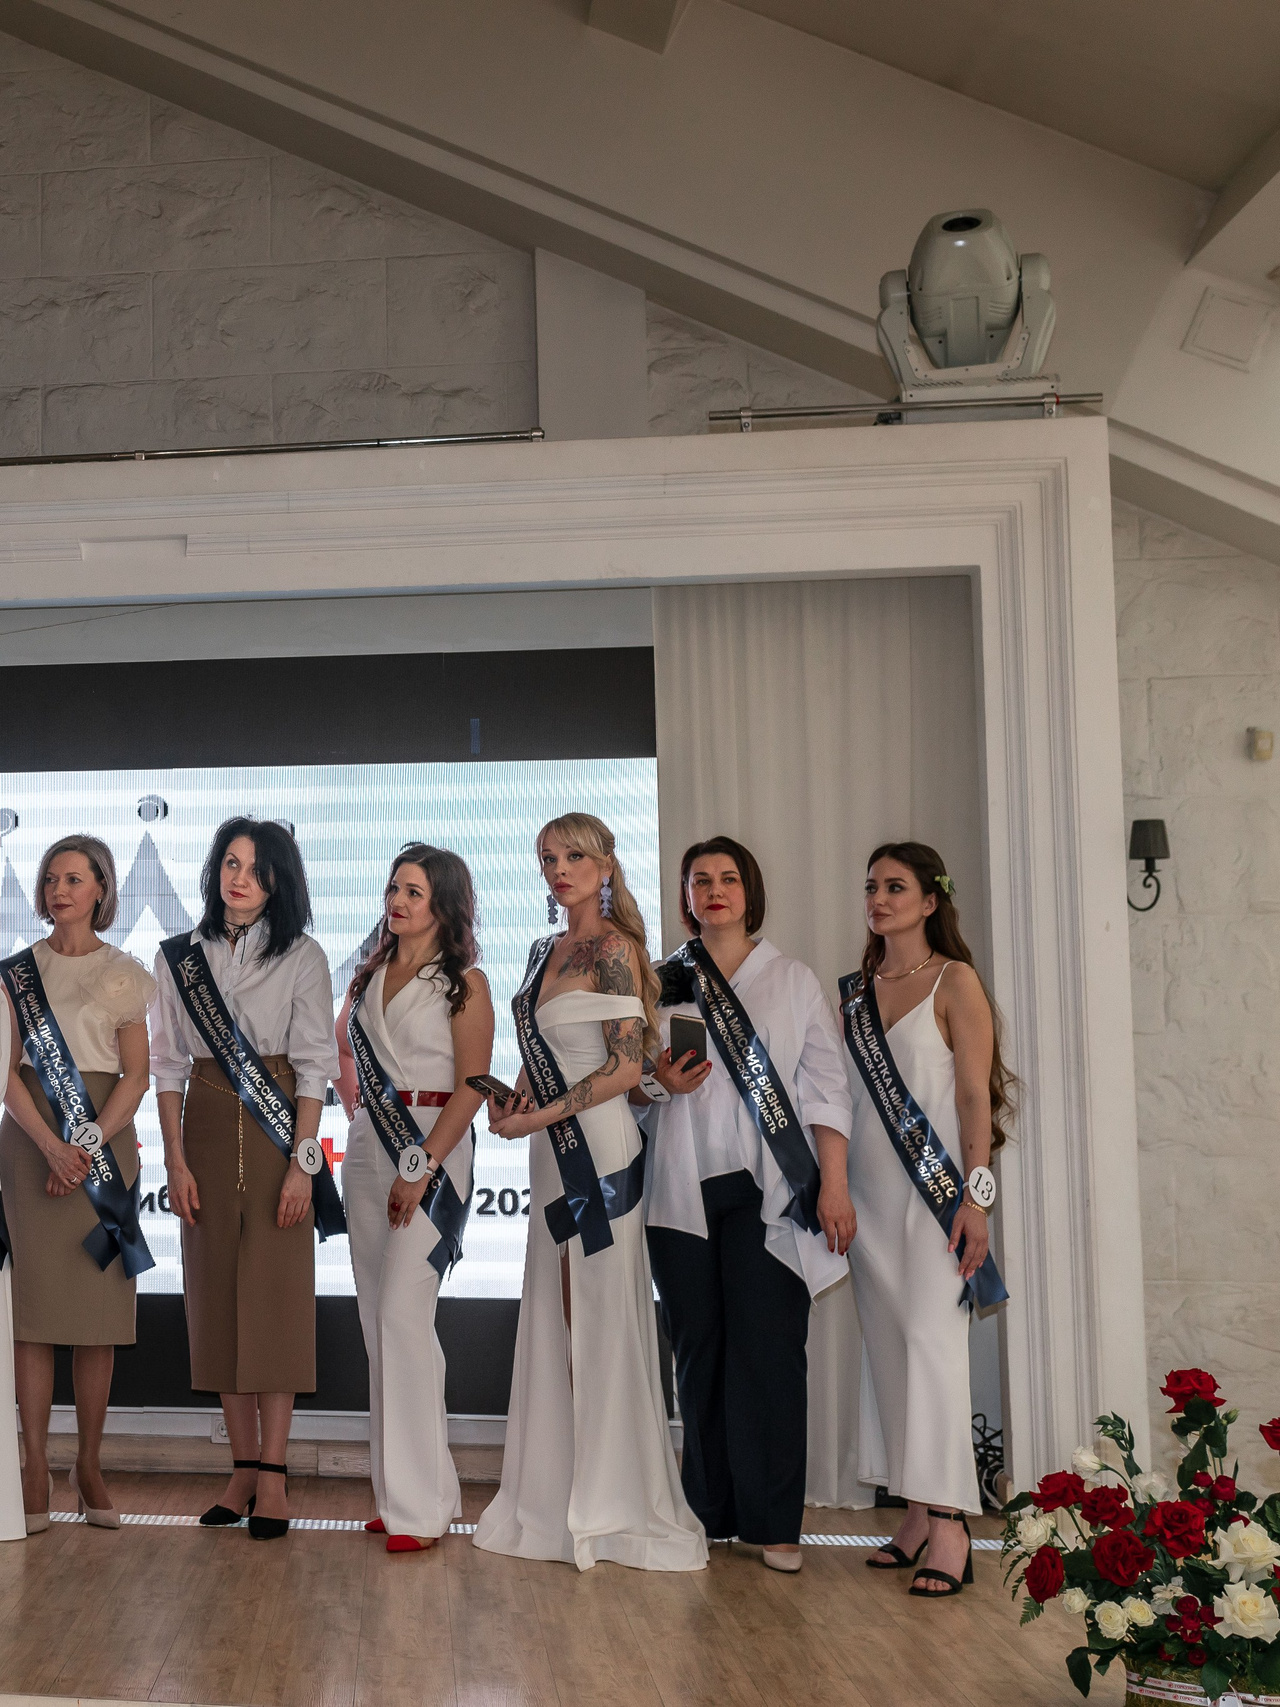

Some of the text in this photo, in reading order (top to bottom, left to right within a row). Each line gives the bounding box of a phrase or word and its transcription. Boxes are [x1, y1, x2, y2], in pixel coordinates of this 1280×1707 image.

[197, 983, 296, 1135] ФИНАЛИСТКА МИССИС БИЗ
[709, 1003, 718, 1011] И
[712, 1010, 756, 1091] НОВОСИБИРСКАЯ
[19, 996, 77, 1134] НОВОСИБИРСК И НОВОСИБИРСК
[26, 991, 113, 1182] ФИНАЛИСТКА МИССИ ЗНЕС
[188, 989, 294, 1151] НОВОСИБИРСК И НОВОСИБИРСКАЯ ОБЛА
[349, 1021, 415, 1146] ИНАЛИСТКА МИССИС
[366, 1086, 404, 1154] НОВОСИБИРСКА
[520, 1029, 549, 1104] НОВОСИБИРСКА
[553, 1123, 567, 1154] ЛАСТЬ
[529, 1037, 559, 1097] МИССИС
[561, 1120, 578, 1149] НЕС
[642, 1079, 665, 1100] 11
[729, 1017, 763, 1075] МИССИС
[757, 1075, 788, 1129] БИЗНЕС
[751, 1089, 777, 1134] ОБЛАСТЬ
[850, 1008, 945, 1204] НОВОСИБИРСК И НОВОСИБИРСКАЯ ОБЛАСТЬ
[858, 1003, 959, 1198] ФИНАЛИСТКА МИССИС БИЗНЕС
[74, 1126, 99, 1152] 12
[306, 1146, 316, 1166] 8
[407, 1154, 419, 1172] 9
[972, 1171, 994, 1201] 13
